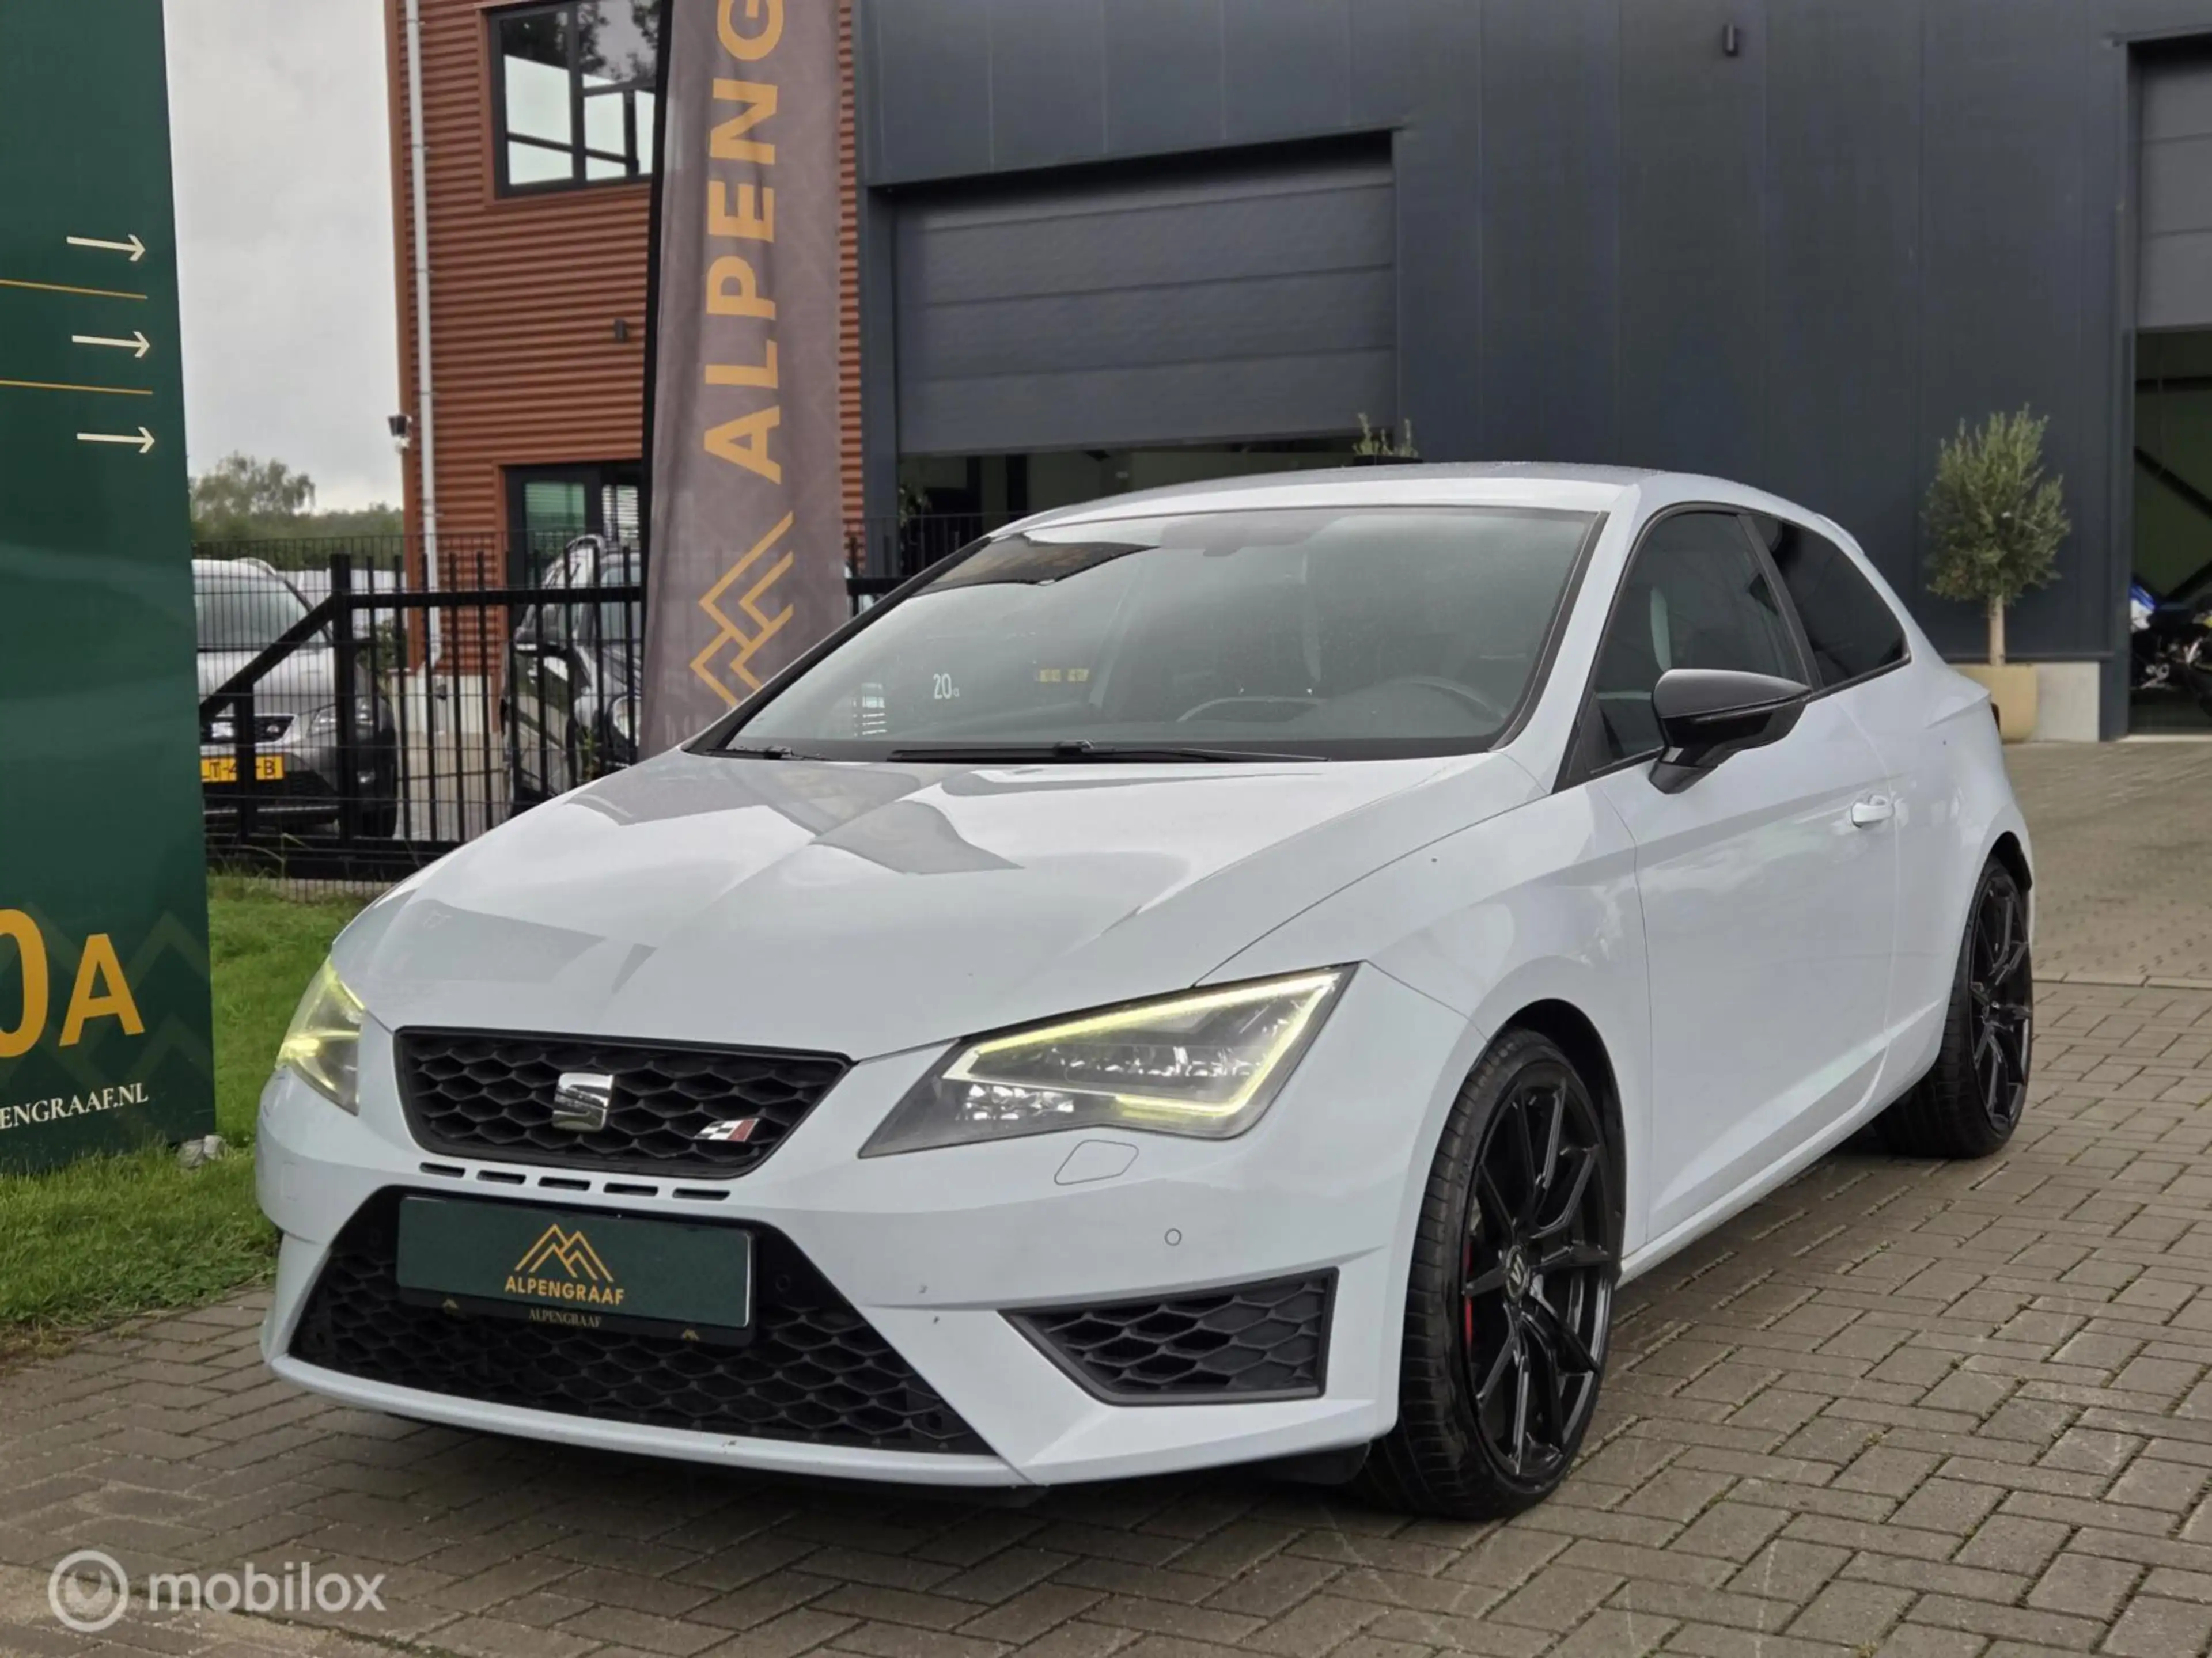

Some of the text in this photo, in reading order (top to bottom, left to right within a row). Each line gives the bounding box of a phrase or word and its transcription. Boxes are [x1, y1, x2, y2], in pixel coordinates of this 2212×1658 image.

[0, 1083, 149, 1130] ENGRAAF.NL
[505, 1275, 625, 1306] ALPENGRAAF
[529, 1308, 603, 1328] ALPENGRAAF
